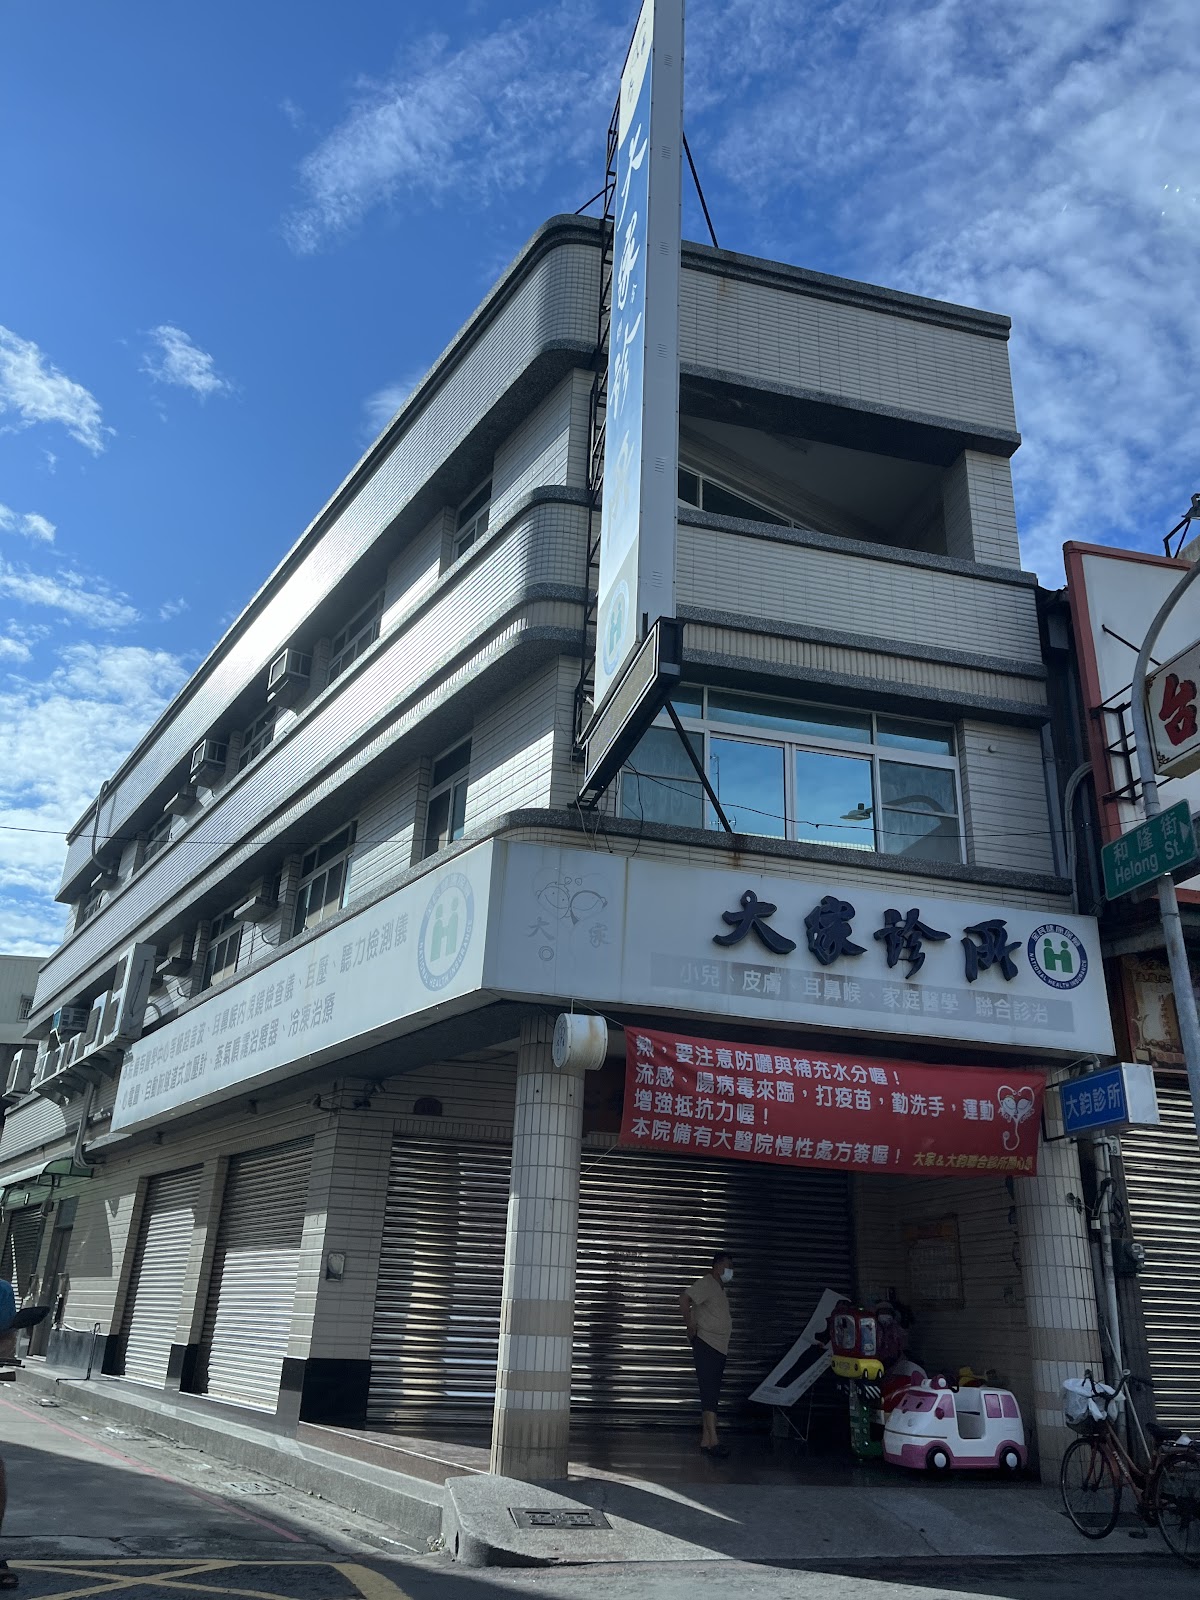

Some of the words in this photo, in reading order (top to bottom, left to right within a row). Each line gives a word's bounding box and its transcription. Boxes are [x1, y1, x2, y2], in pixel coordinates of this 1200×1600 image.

[1159, 673, 1198, 747] 台
[1113, 812, 1177, 865] 和隆街
[1115, 853, 1159, 886] Helong
[1164, 839, 1184, 861] St.
[712, 889, 1023, 984] 大家診所
[1065, 1082, 1122, 1120] 大鈞診所
